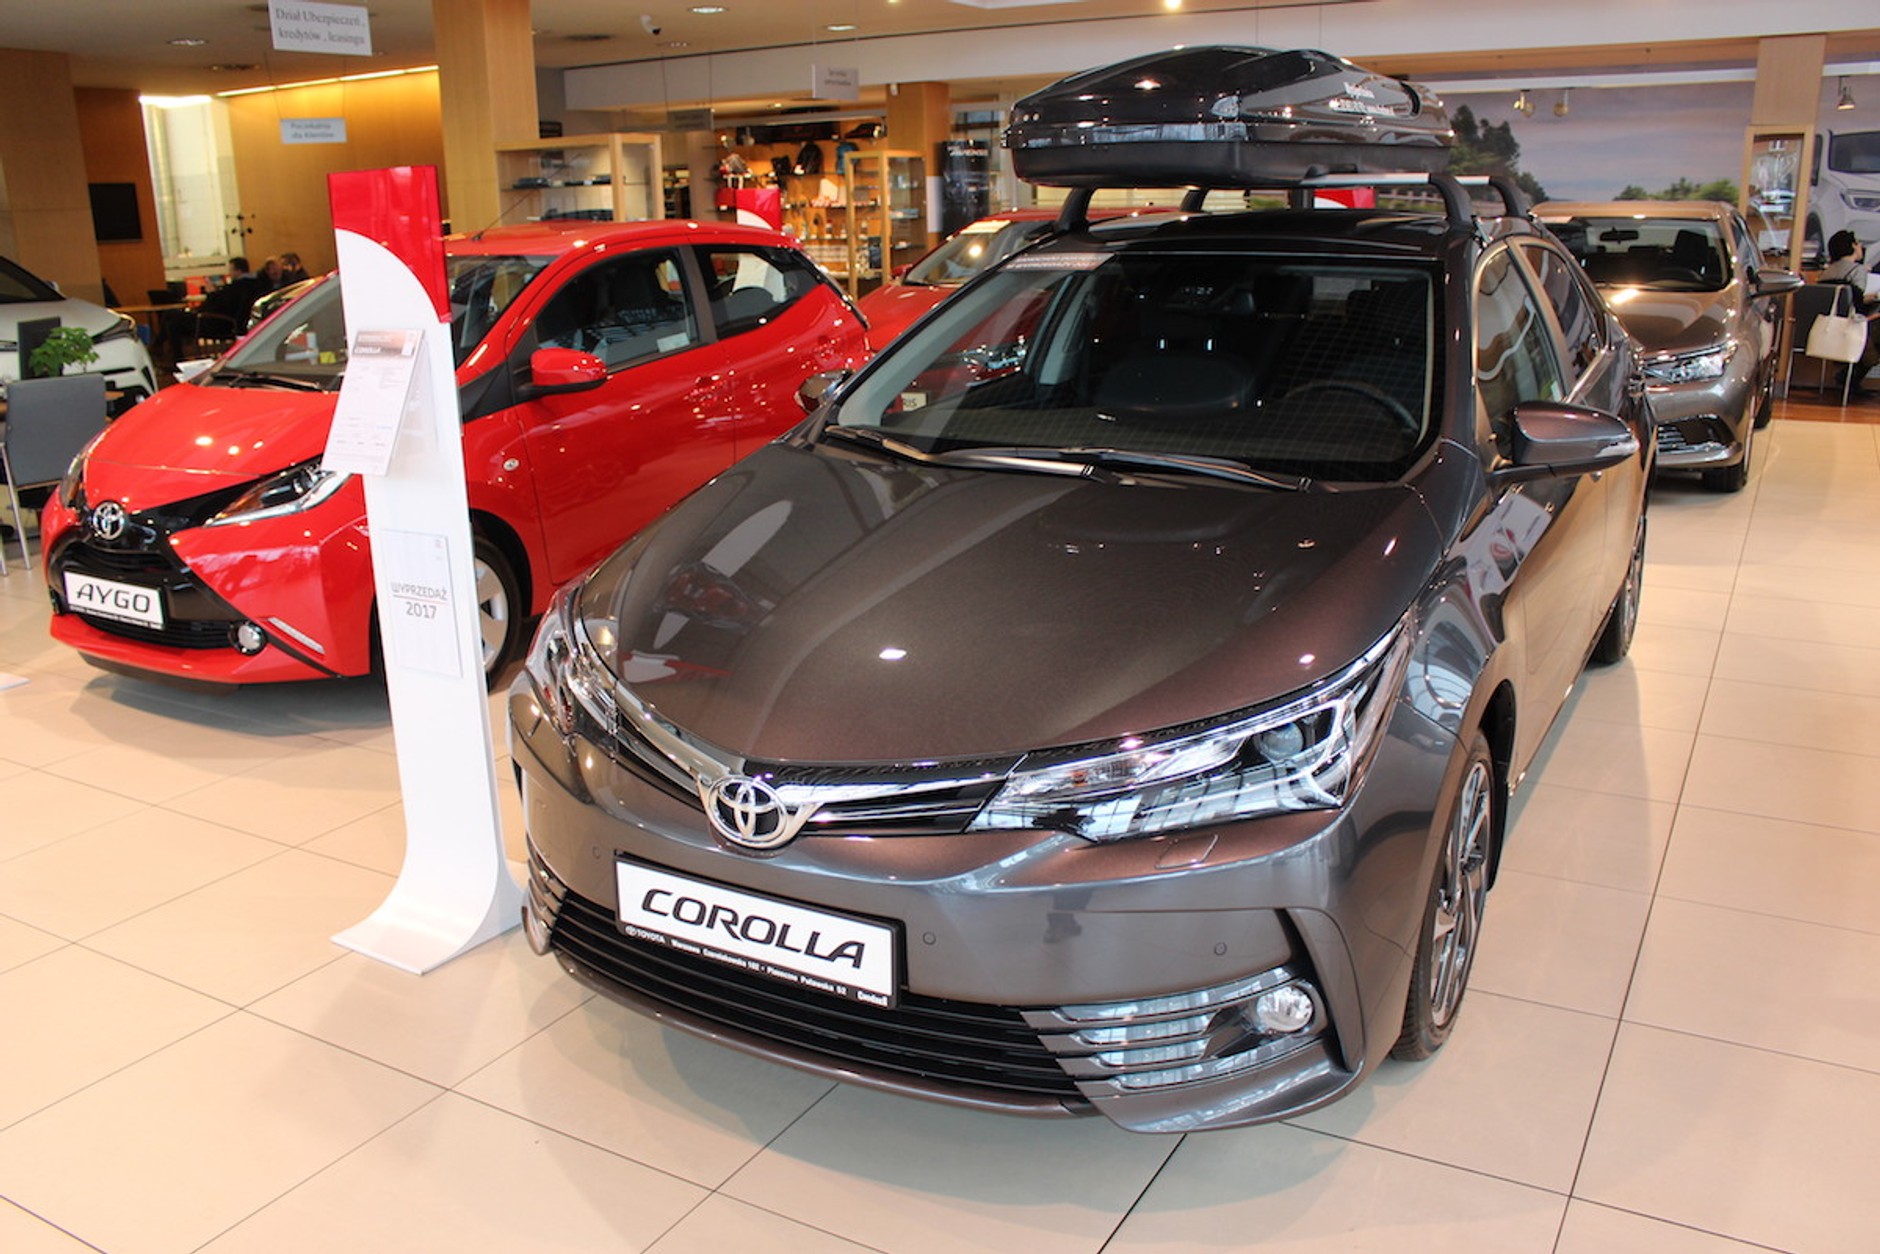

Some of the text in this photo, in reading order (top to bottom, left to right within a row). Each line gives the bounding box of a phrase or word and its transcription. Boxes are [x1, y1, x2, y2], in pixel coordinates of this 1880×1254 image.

[76, 582, 150, 613] AYGO
[390, 582, 448, 601] WYPRZEDAŻ
[405, 601, 437, 619] 2017
[641, 887, 866, 969] COROLLA
